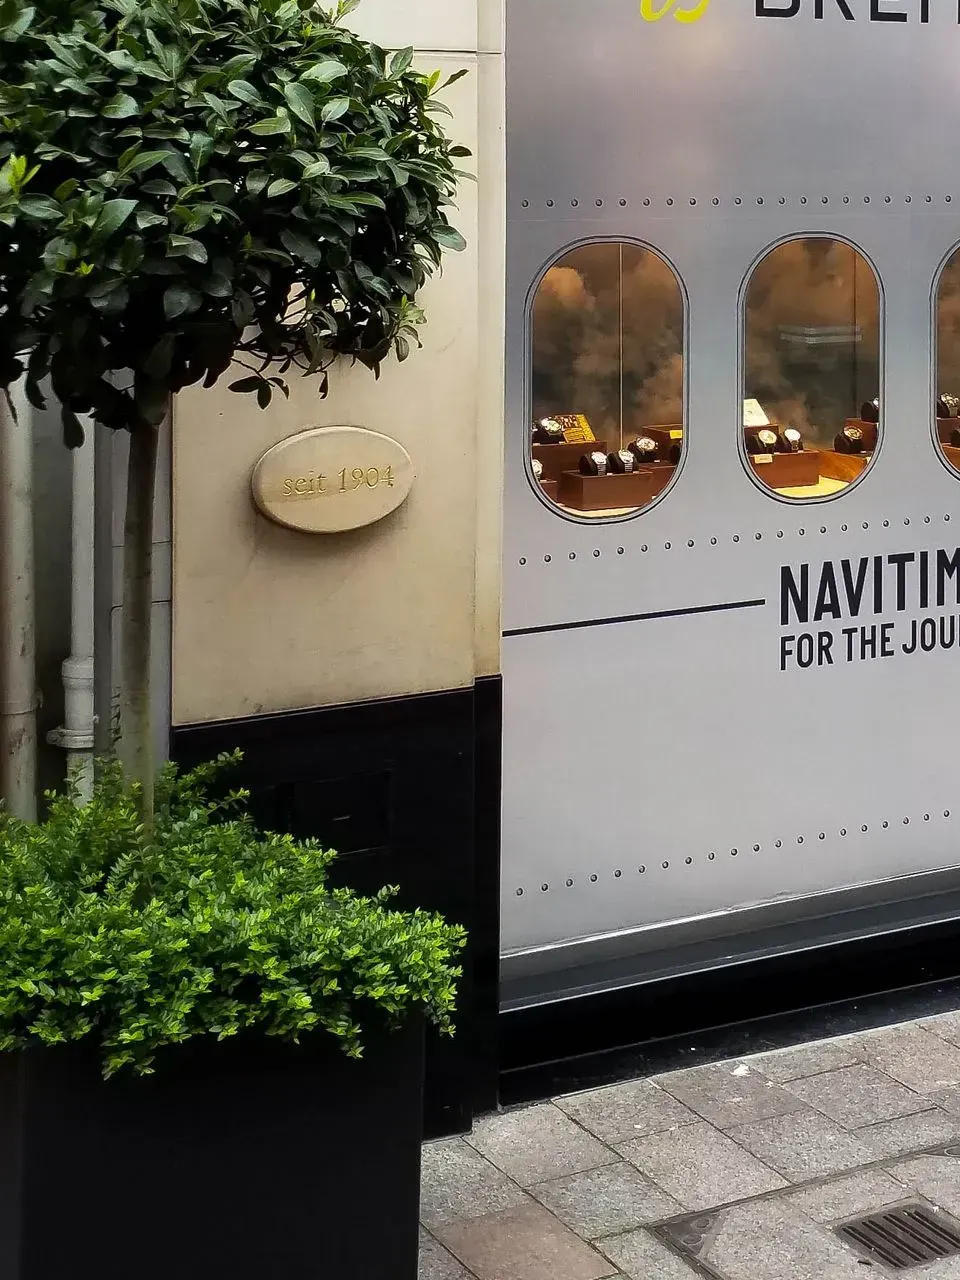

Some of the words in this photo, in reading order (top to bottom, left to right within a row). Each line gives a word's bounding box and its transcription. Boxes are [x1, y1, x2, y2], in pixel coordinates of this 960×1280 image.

[282, 470, 327, 496] seit
[338, 465, 395, 493] 1904
[780, 631, 834, 671] FOR
[842, 622, 895, 662] THE
